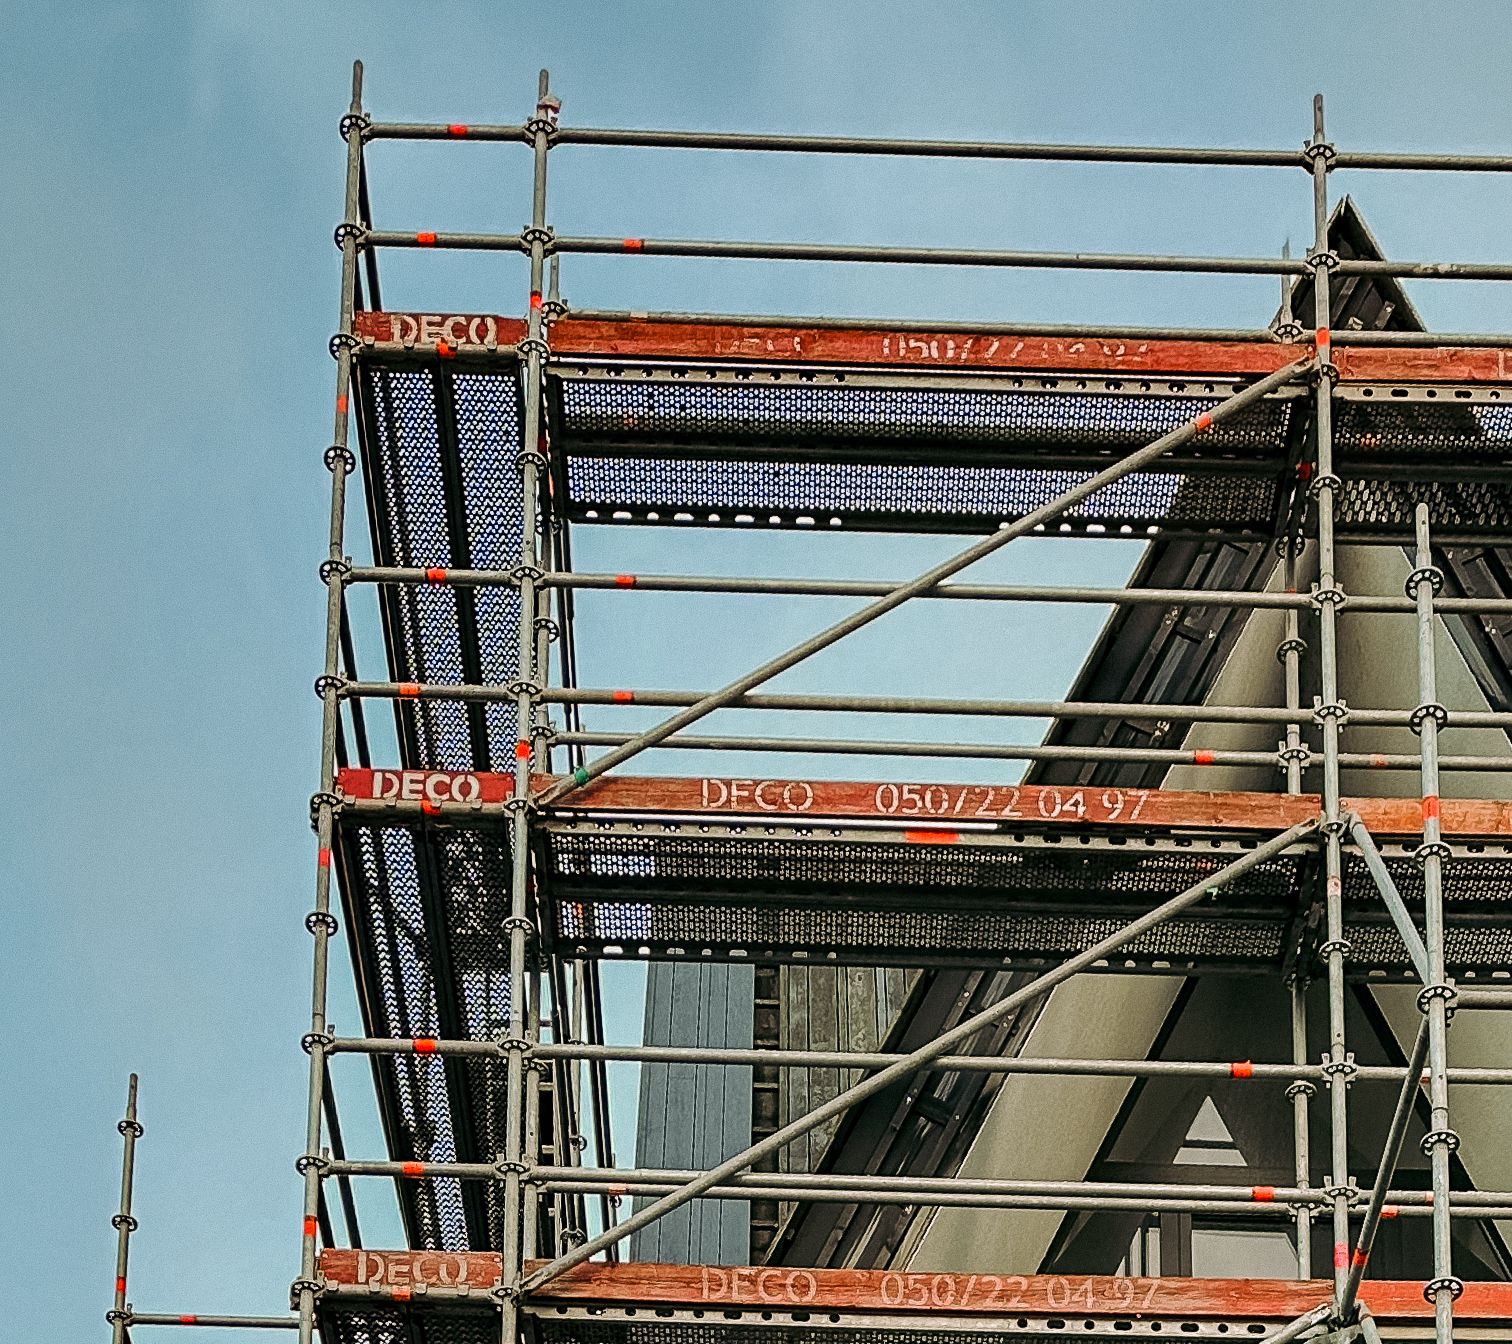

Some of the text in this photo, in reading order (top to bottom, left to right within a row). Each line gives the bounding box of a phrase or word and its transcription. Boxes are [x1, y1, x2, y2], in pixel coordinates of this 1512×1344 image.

[391, 315, 497, 344] DECO
[373, 772, 479, 802] DECO
[875, 783, 1023, 817] 050/22
[1038, 787, 1086, 819] 04
[1101, 789, 1149, 820] 97
[359, 1254, 467, 1288] DECO
[702, 1268, 1159, 1310] DECO 050/22 04 97
